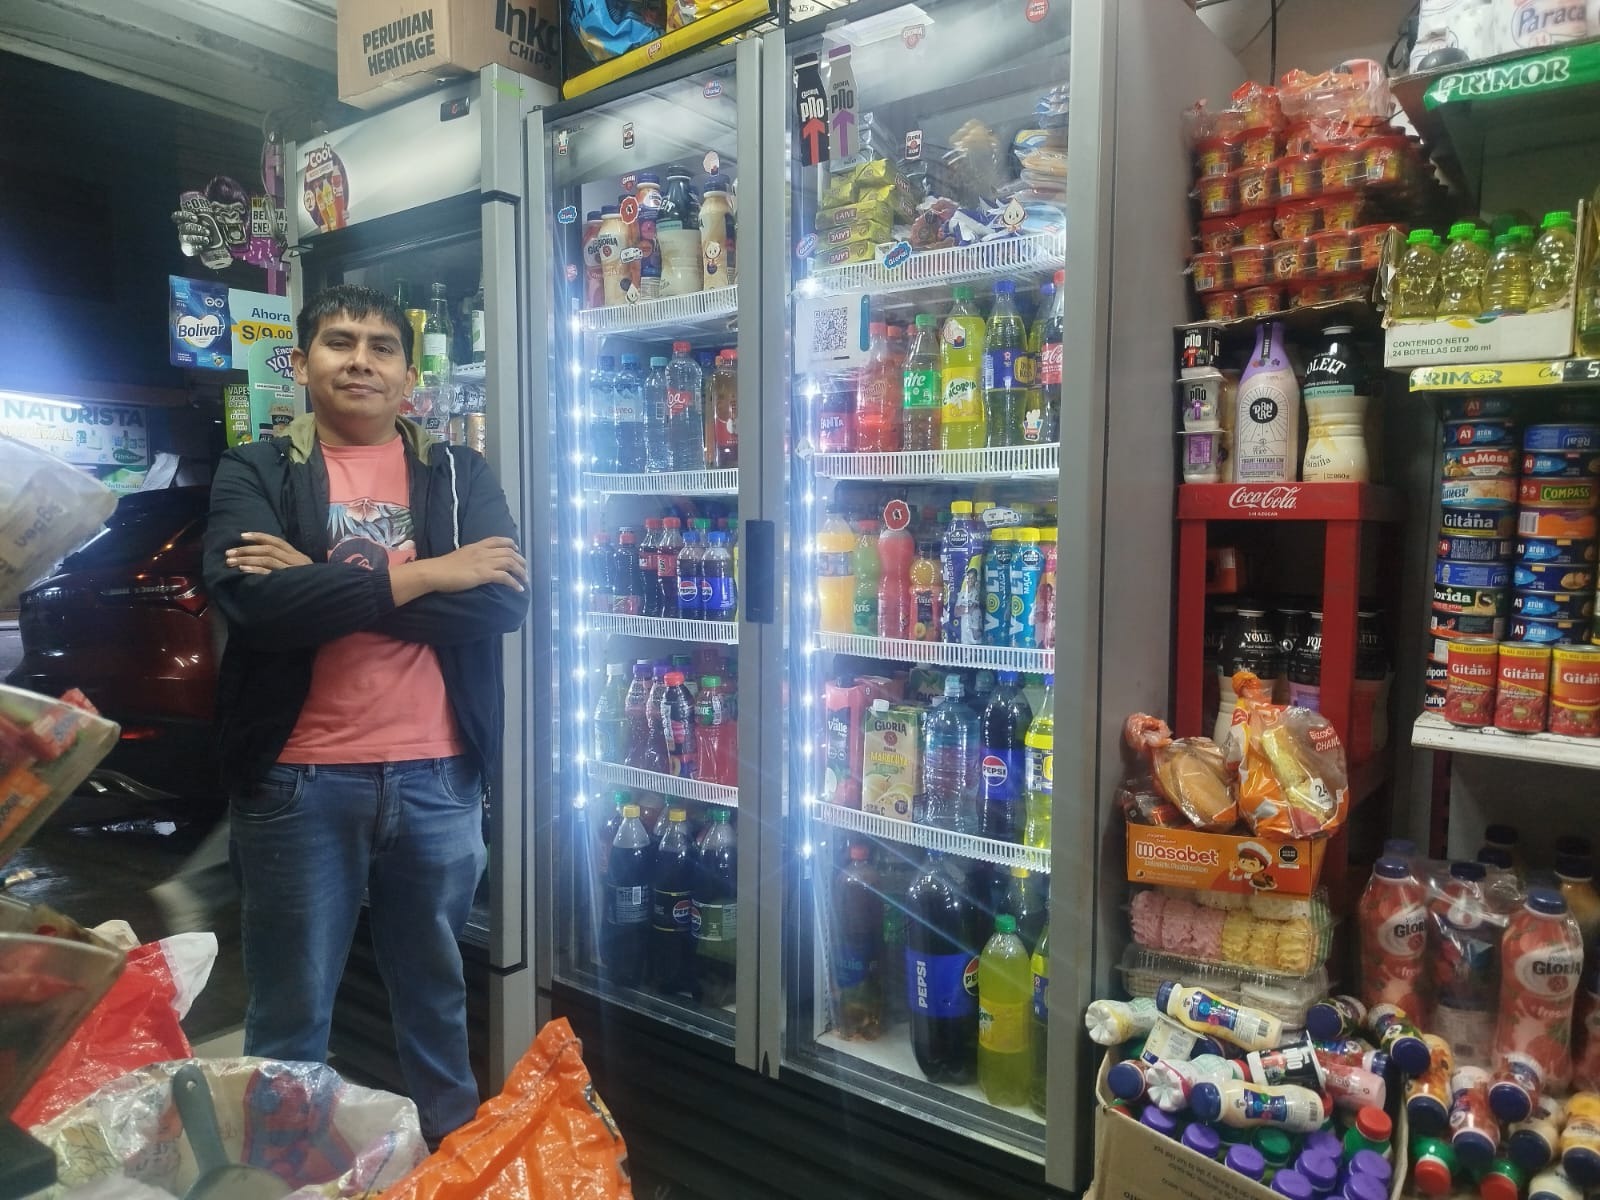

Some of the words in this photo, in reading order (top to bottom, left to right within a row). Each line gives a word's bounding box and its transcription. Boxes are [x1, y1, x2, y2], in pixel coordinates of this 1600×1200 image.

[363, 9, 434, 55] PERUVIAN
[367, 33, 436, 77] HERITAGE
[1438, 56, 1570, 96] PRIMOR
[251, 307, 290, 322] Ahora
[1392, 338, 1442, 348] CONTENIDO
[1445, 336, 1470, 345] NETO
[1392, 349, 1402, 357] 24
[1403, 347, 1448, 356] BOTELLAS
[1464, 344, 1479, 352] 200
[4, 400, 144, 427] NATURISTA
[1228, 486, 1301, 509] Coca-Cola
[1543, 487, 1590, 501] COMPASS
[1444, 514, 1494, 528] Gitana
[1514, 625, 1524, 634] A1
[874, 720, 907, 736] GLORIA
[982, 766, 1007, 776] PEPSI
[1532, 960, 1582, 976] GLORIA
[916, 960, 929, 1009] PEPSI
